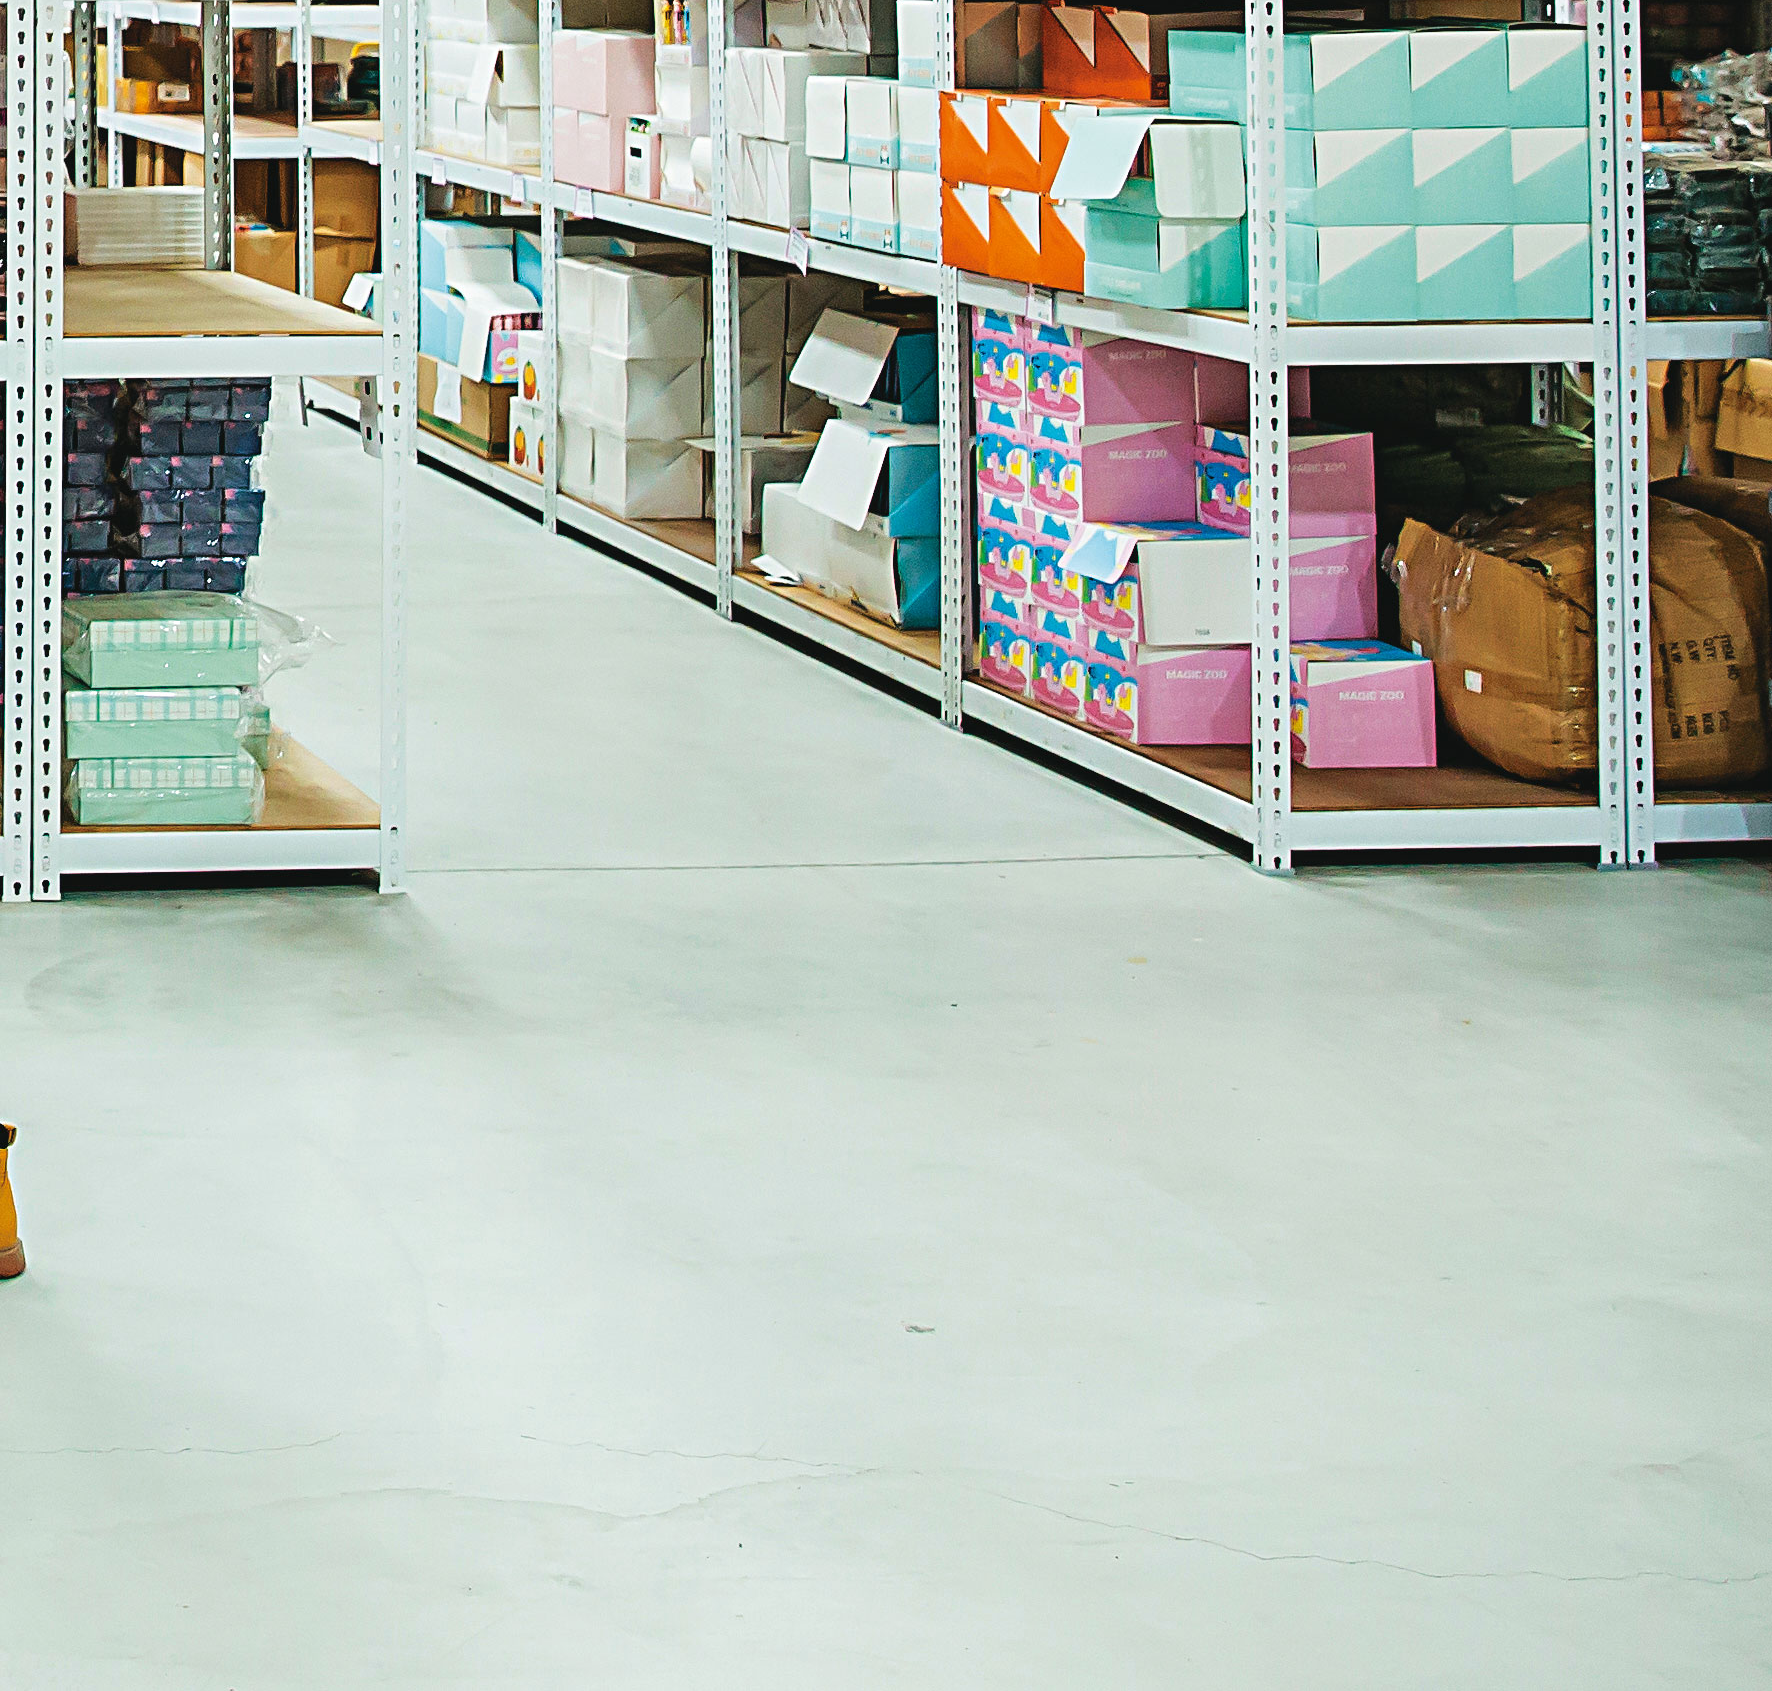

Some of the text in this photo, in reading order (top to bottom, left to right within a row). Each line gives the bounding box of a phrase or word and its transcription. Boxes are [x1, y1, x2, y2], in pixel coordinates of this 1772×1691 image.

[1108, 450, 1142, 460] MAGIC
[1165, 669, 1228, 679] MAGIC ZOO
[1339, 690, 1405, 701] MAGIC ZOO
